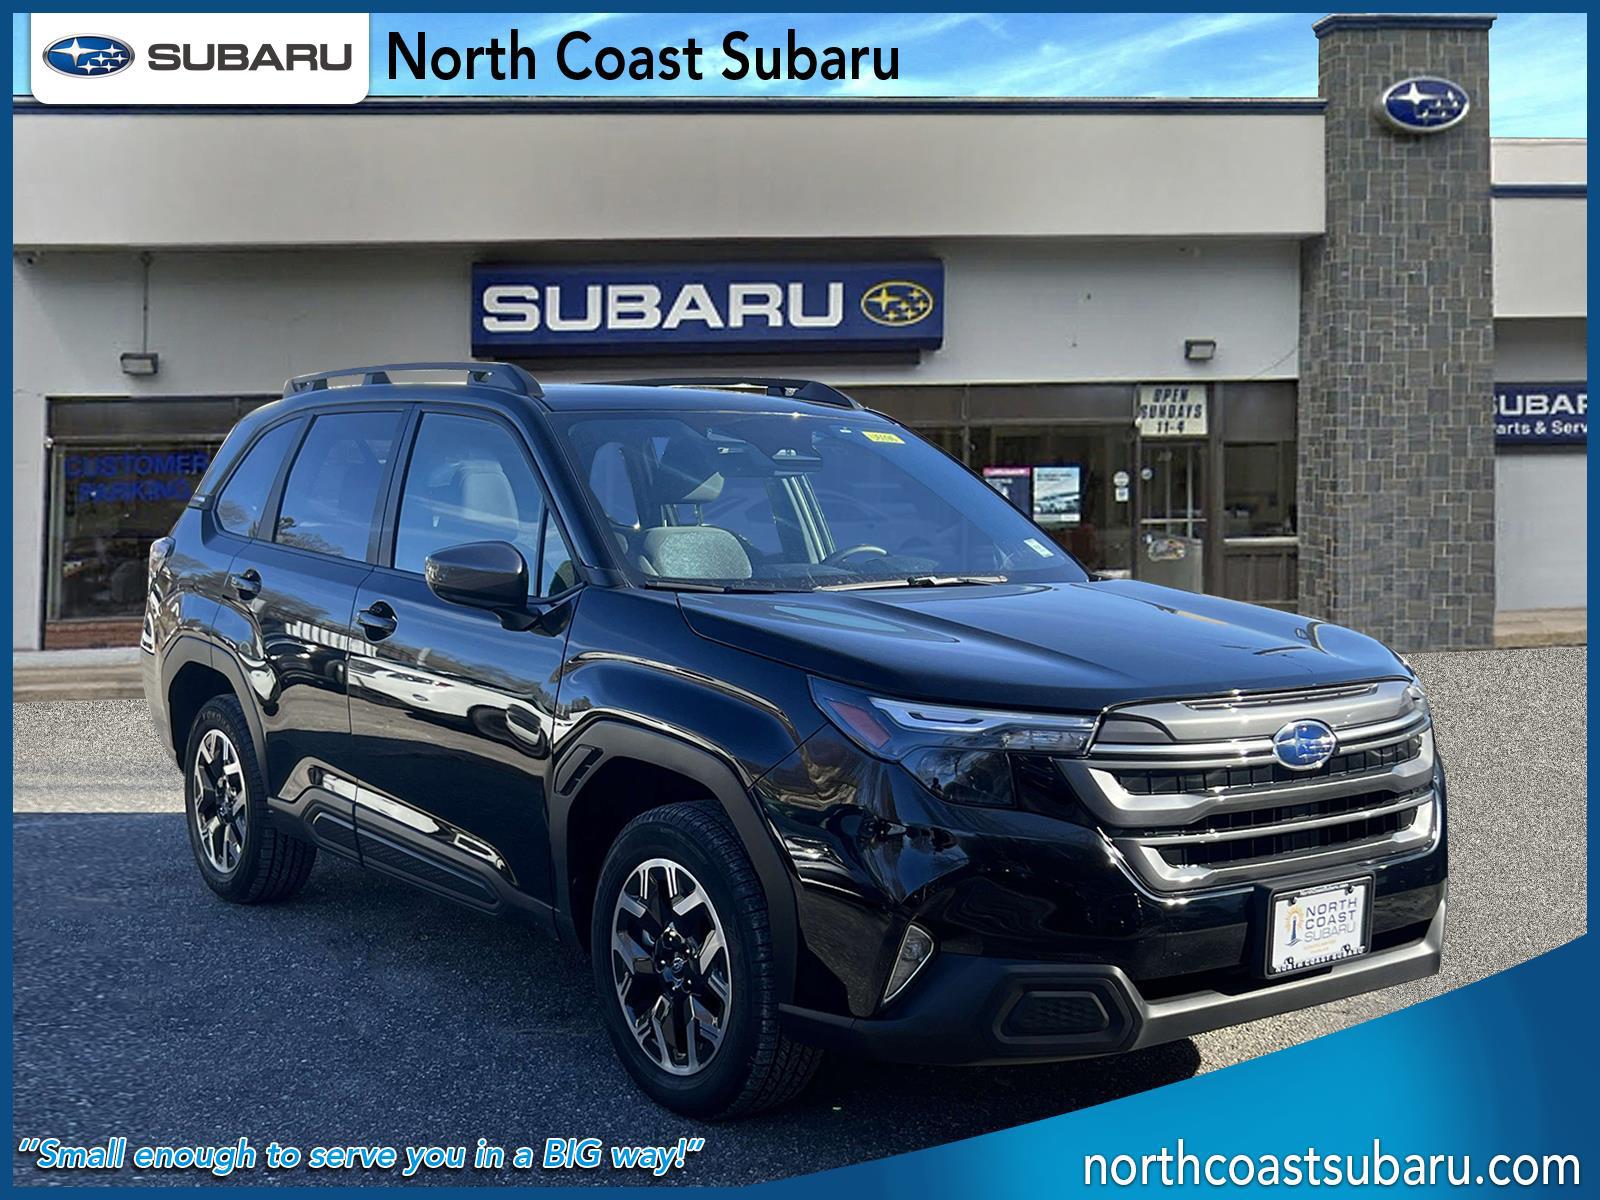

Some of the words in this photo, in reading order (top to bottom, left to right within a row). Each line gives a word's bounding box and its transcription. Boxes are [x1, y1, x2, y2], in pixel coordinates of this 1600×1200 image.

[482, 281, 843, 333] SUBARU
[1153, 388, 1189, 403] OPEN
[1493, 394, 1588, 416] UBA
[1140, 403, 1203, 419] SUNDAYS
[1157, 420, 1185, 433] 11-4
[1494, 422, 1532, 436] arts
[1534, 420, 1547, 435] &
[64, 451, 209, 477] CUSTOMER
[78, 479, 192, 503] PARKING
[1305, 897, 1358, 918] NORTH
[1304, 909, 1357, 930] COAST
[1303, 920, 1357, 943] SUBARU
